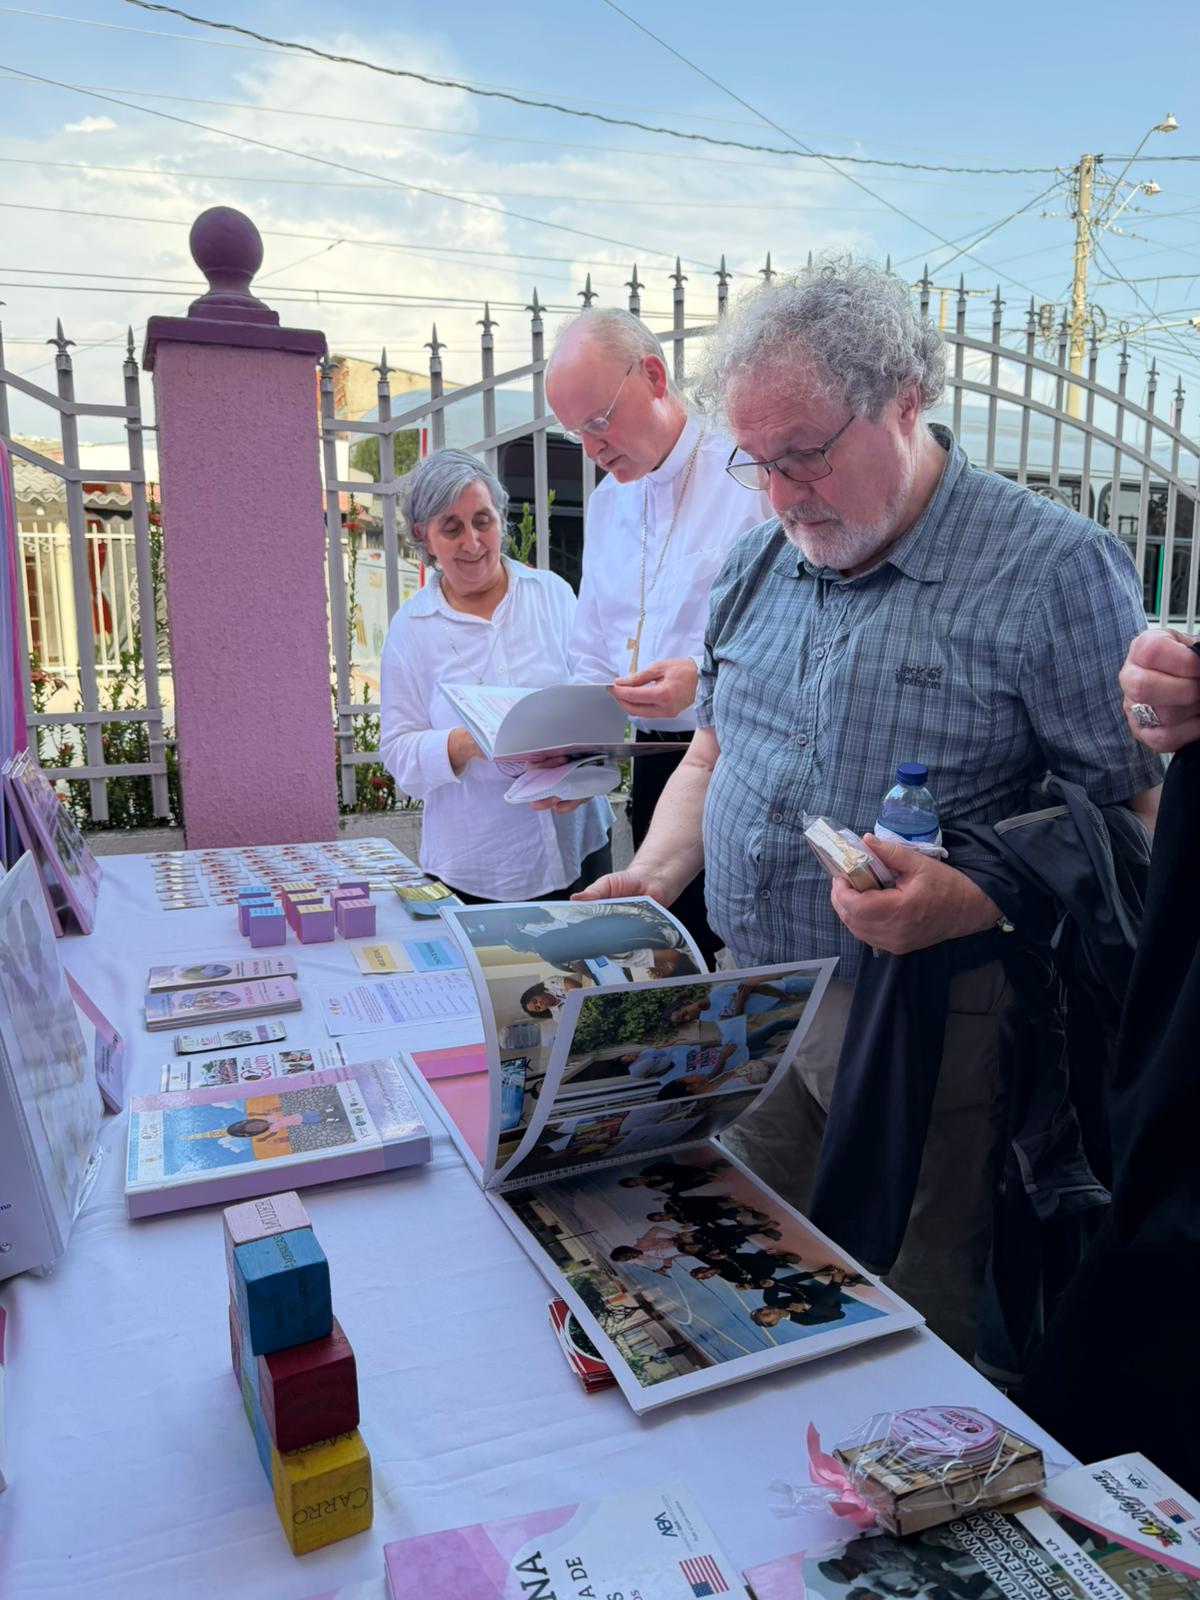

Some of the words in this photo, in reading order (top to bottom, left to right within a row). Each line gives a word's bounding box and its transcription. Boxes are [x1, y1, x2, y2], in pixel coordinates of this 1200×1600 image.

[293, 1487, 369, 1527] CARRO
[654, 1511, 679, 1538] ABA
[984, 1510, 1060, 1586] PERSONAS
[1045, 1538, 1062, 1554] LA
[565, 1556, 588, 1582] DE
[1058, 1552, 1075, 1567] DE
